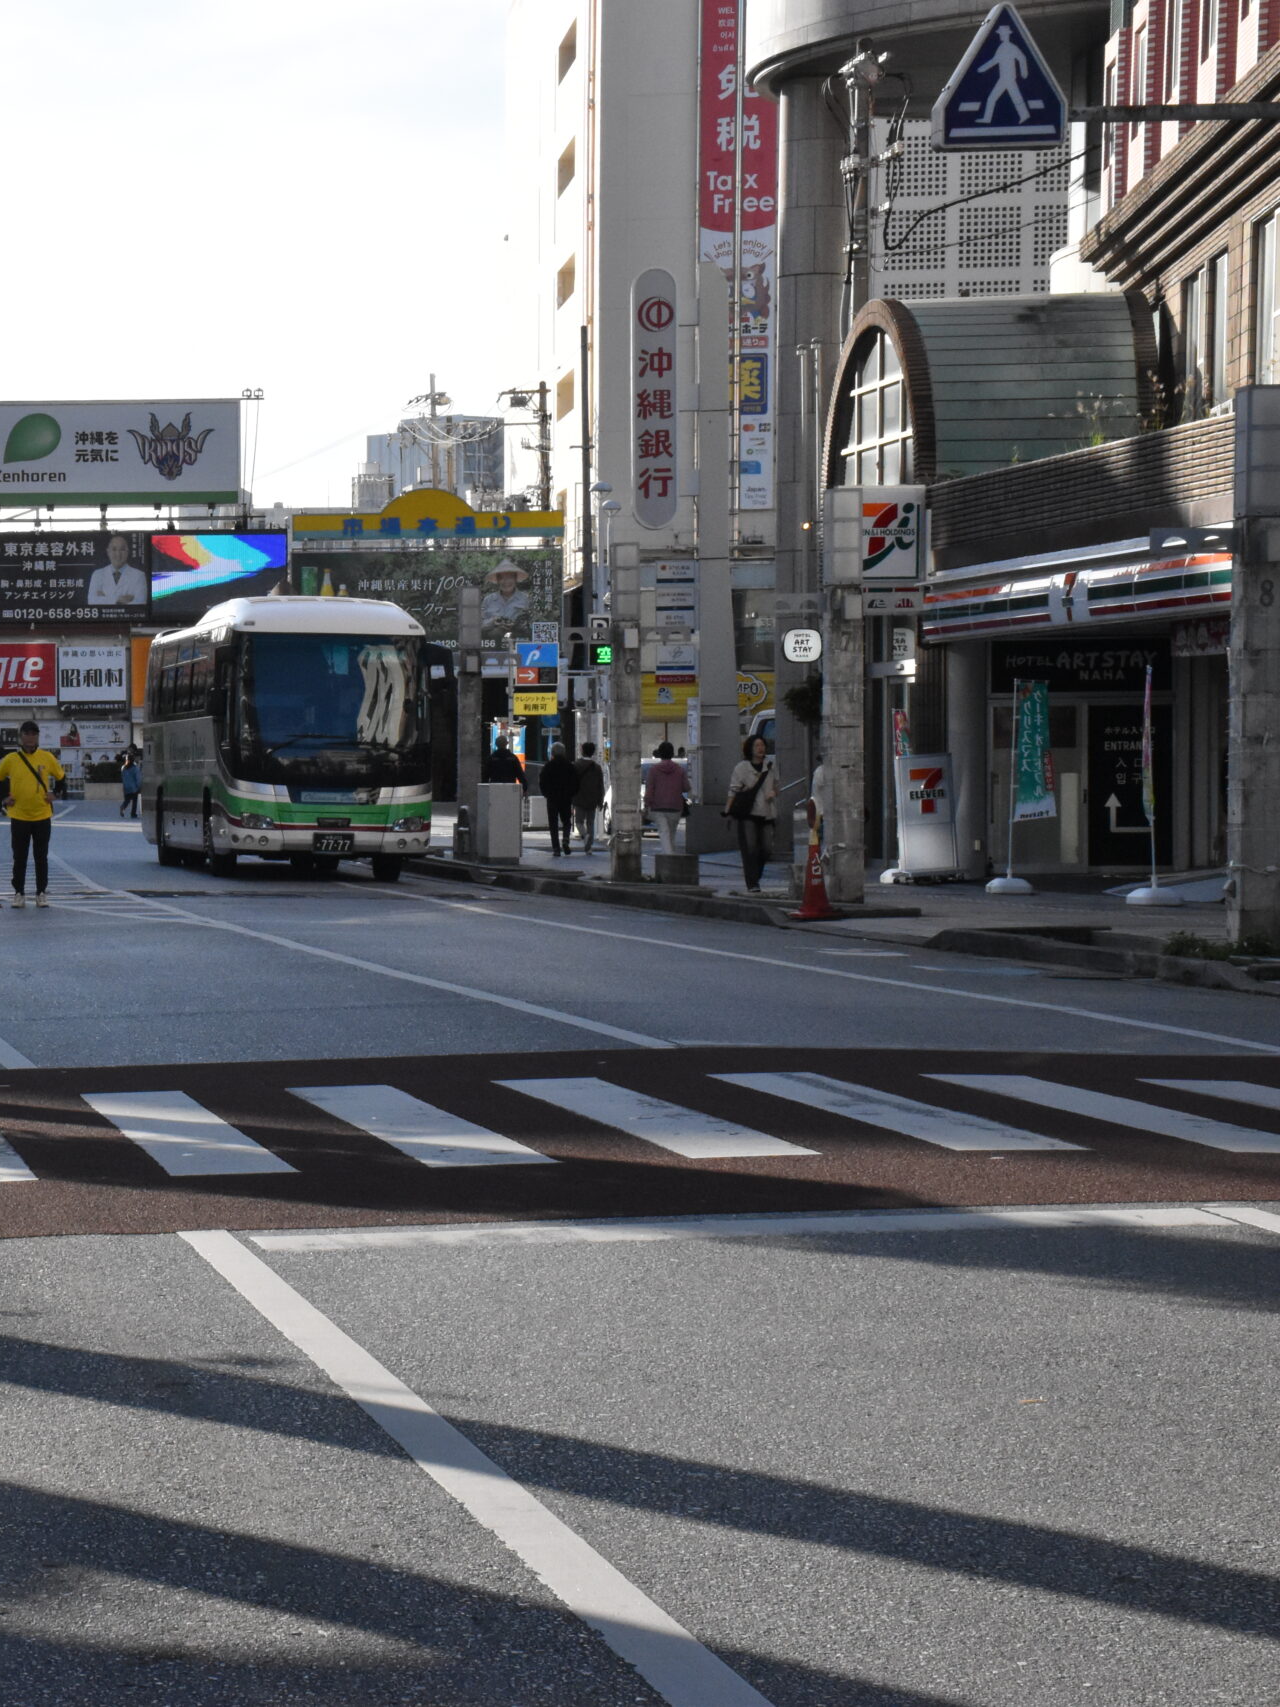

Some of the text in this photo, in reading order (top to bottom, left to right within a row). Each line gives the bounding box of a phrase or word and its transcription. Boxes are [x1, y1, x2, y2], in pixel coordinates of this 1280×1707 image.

[706, 171, 758, 190] Tax
[713, 194, 775, 214] Free
[637, 347, 674, 500] 沖縄銀行
[74, 431, 119, 446] 沖縄を
[74, 448, 119, 462] 元気に
[342, 516, 512, 536] 市場本通り
[880, 528, 916, 536] HOLDINGS
[3, 541, 95, 557] 東京美容外科
[22, 560, 57, 571] 沖縄院
[4, 590, 76, 600] アンチエイジング
[1260, 579, 1274, 607] 8
[14, 608, 99, 619] 0120-658-958
[1006, 655, 1055, 668] HOTEL
[60, 668, 124, 688] 昭和村
[1080, 670, 1126, 681] NAHA
[523, 703, 547, 711] 利用可
[1104, 740, 1155, 752] ENTRANE
